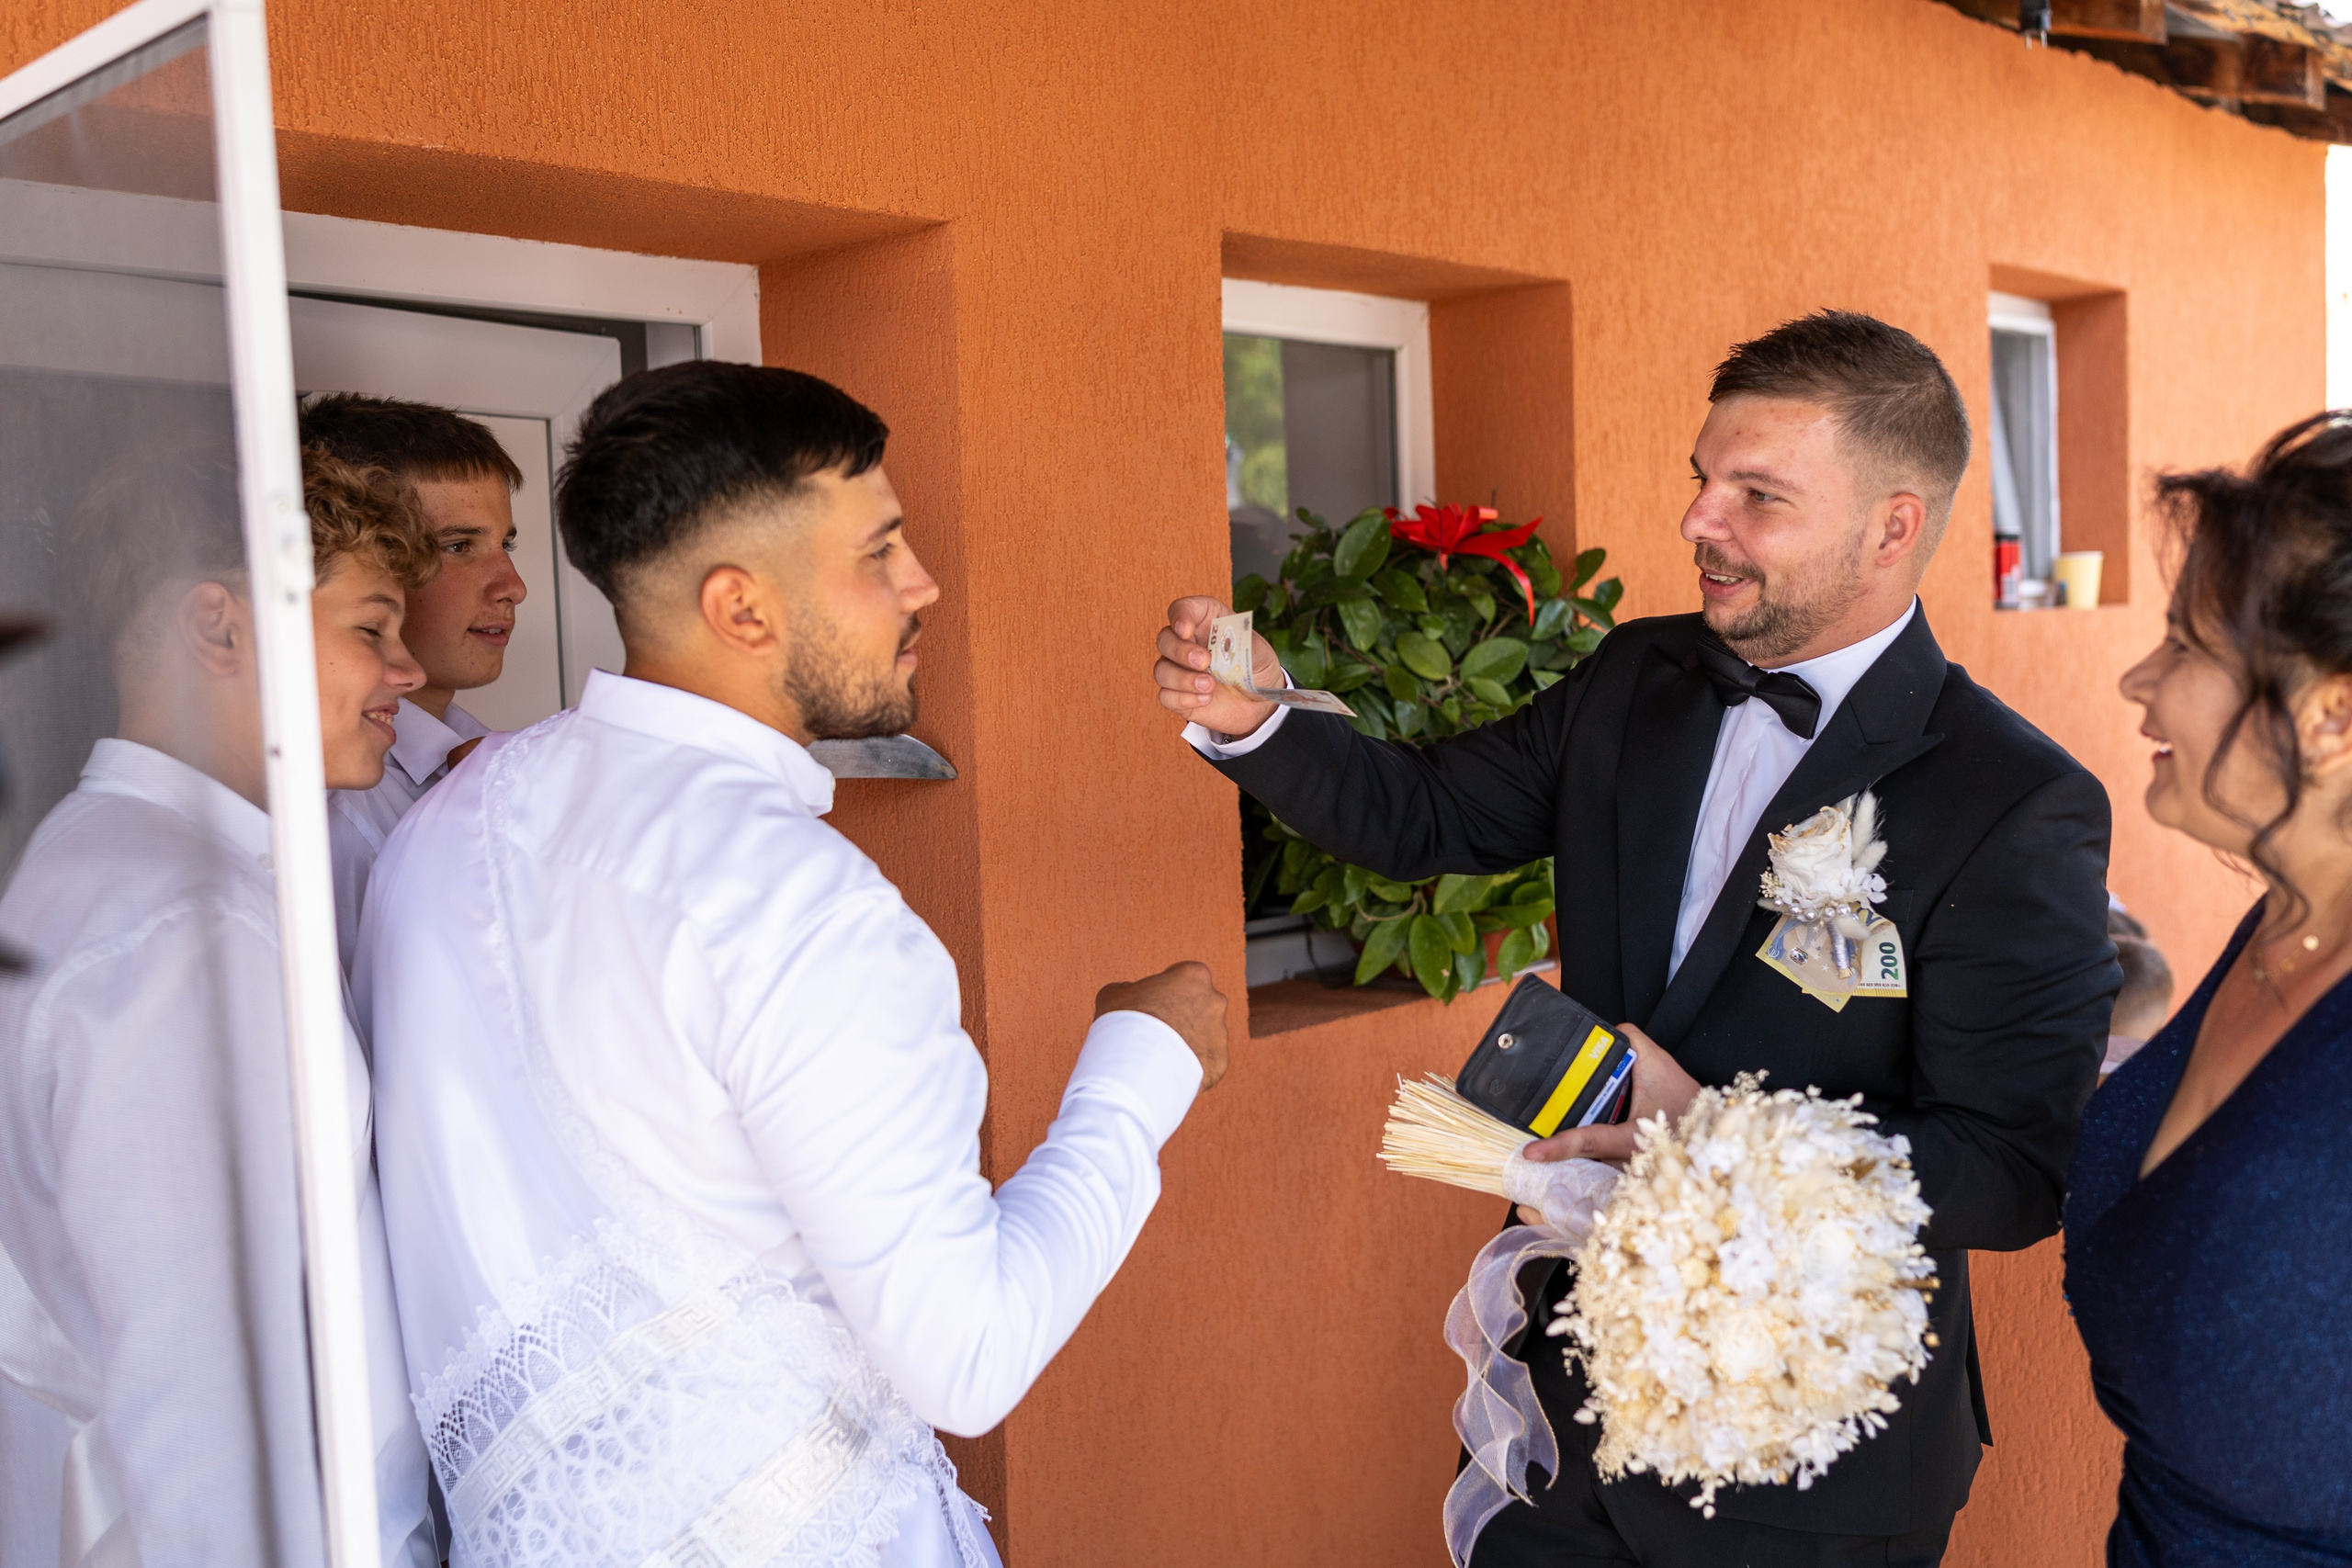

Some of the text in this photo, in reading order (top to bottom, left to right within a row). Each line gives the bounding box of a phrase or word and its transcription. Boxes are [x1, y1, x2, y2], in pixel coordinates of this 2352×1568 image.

[1210, 624, 1218, 645] 20
[1879, 942, 1899, 980] 200
[1589, 1036, 1610, 1059] VISA
